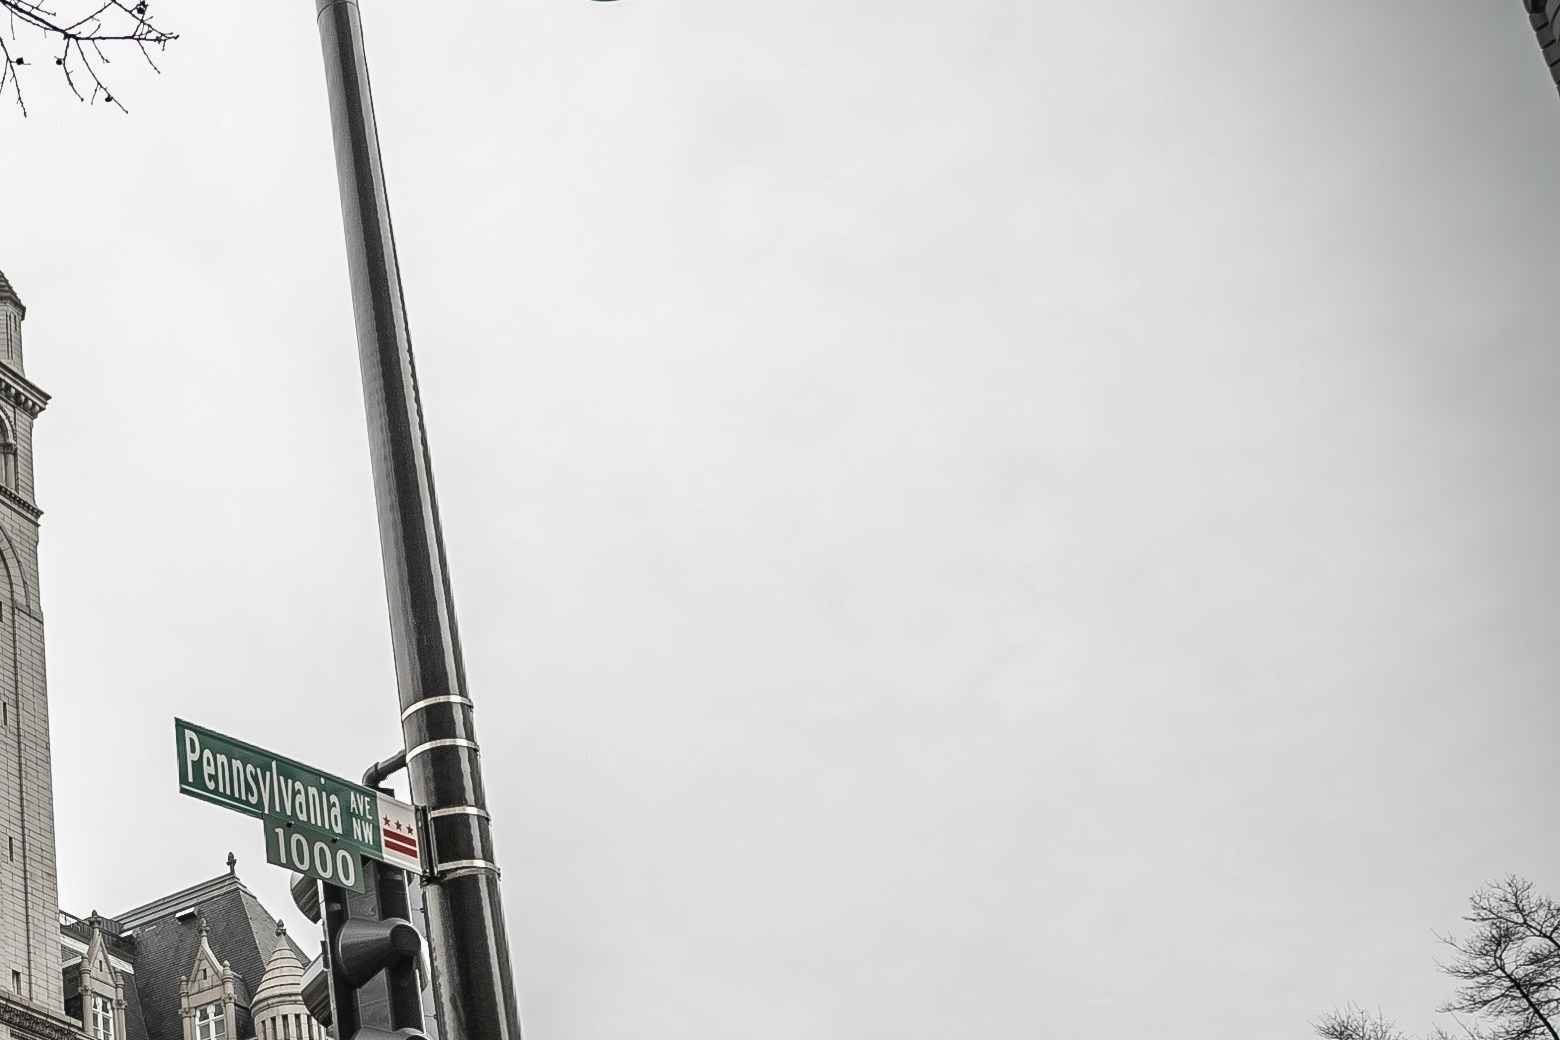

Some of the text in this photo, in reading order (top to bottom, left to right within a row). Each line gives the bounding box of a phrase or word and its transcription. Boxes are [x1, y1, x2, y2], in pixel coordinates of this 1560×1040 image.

[184, 728, 343, 835] Pennsylvania
[350, 792, 373, 820] AVE
[352, 819, 374, 846] NW
[275, 827, 356, 888] 1000
